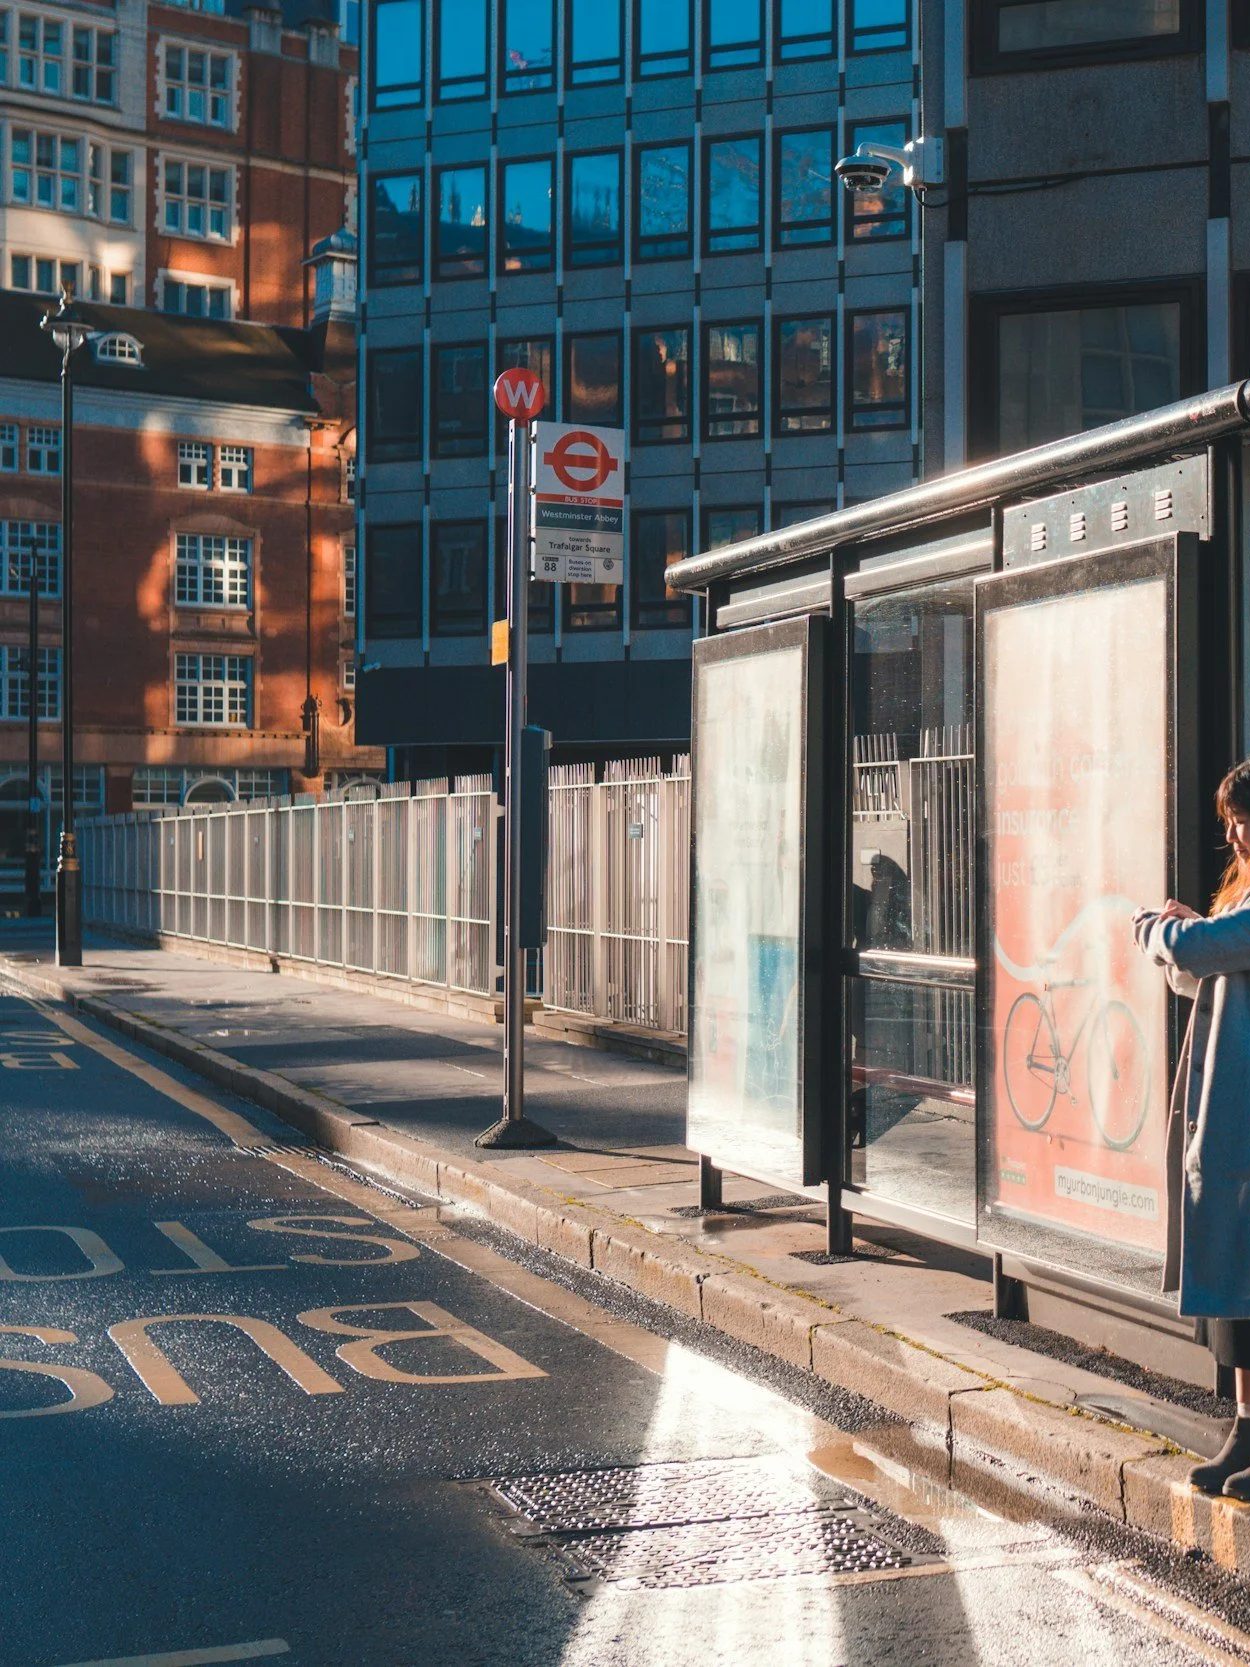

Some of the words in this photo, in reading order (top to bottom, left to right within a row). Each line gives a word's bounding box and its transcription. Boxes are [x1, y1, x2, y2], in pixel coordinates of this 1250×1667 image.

[503, 379, 540, 409] W
[564, 495, 578, 504] BUS
[541, 509, 593, 521] Westminster
[594, 512, 619, 524] Abbey
[568, 536, 592, 544] towards
[548, 541, 583, 553] Trafalgar
[585, 543, 611, 555] Square
[543, 562, 557, 573] 88
[568, 558, 583, 566] Buses
[568, 565, 593, 573] diversion
[568, 571, 581, 579] stop
[581, 571, 593, 579] here
[996, 804, 1081, 837] insurance
[996, 854, 1027, 894] just
[1056, 1173, 1156, 1212] myurbanjungle.com
